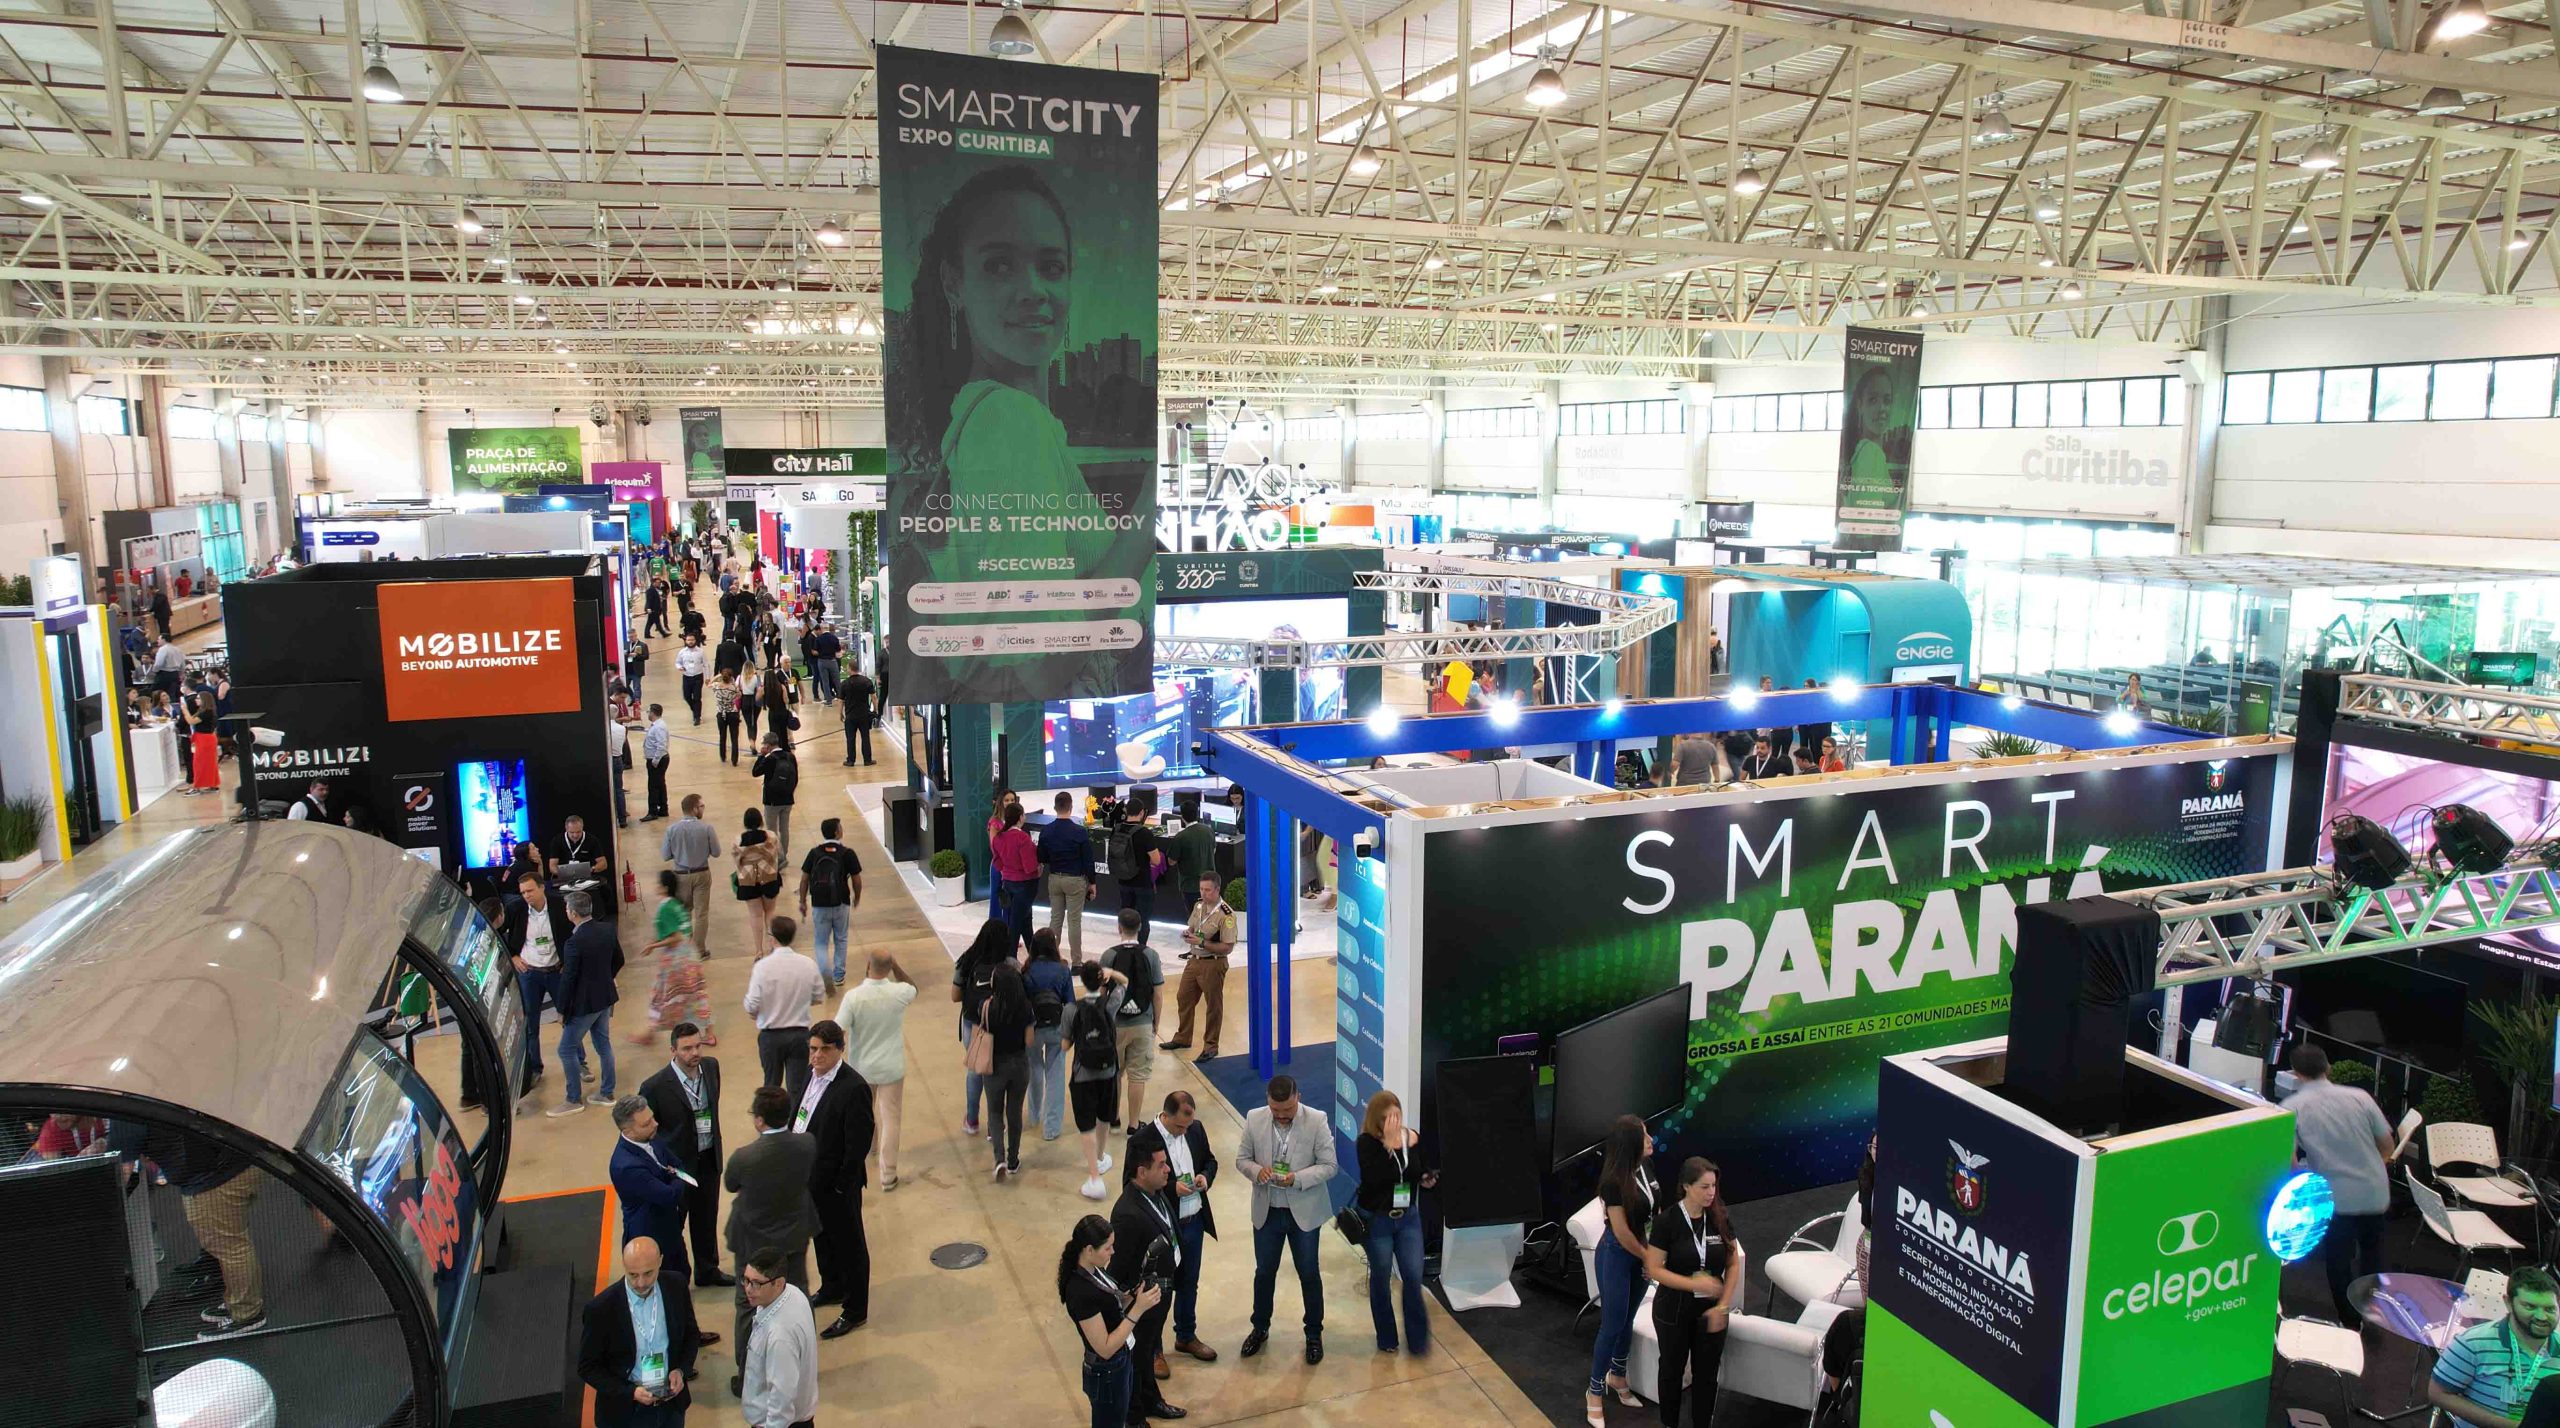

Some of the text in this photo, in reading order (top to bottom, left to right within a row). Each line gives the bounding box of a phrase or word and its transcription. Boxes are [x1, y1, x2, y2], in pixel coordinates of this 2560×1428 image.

[898, 83, 1142, 138] SMARTCITY
[898, 126, 1052, 155] EXPO CURITIBA
[1850, 338, 1918, 358] SMARTCITY
[682, 410, 719, 418] SMARTCITY
[1167, 402, 1204, 410] SMARTCITY
[2045, 435, 2083, 452] Sala
[466, 447, 537, 461] PRAÇA DE
[773, 454, 853, 473] City Hall
[467, 461, 568, 478] ALIMENTAÇÃO
[2021, 449, 2169, 487] Curitiba
[925, 493, 1123, 511] CONNECTING CITIES
[899, 514, 1147, 533] PEOPLE & TECHNOLOGY
[977, 557, 1076, 572] #SCECWB23
[1007, 636, 1035, 645] iCities
[1044, 635, 1092, 644] SMARTCITY
[401, 655, 539, 671] BEYOND AUTOMOTIVE
[290, 768, 350, 779] AUTOMOTIVE
[2181, 790, 2244, 814] PARANÁ
[1622, 790, 2076, 915] SMART
[2479, 942, 2515, 958] Imagine
[2516, 954, 2532, 963] um
[1688, 1040, 1747, 1060] GROSSA
[1751, 1038, 1760, 1050] E
[1763, 1027, 1806, 1047] ASSAÍ
[1810, 1022, 1854, 1040] ENTRE
[1857, 1019, 1875, 1033] AS
[1878, 1017, 1891, 1030] 21
[1894, 1002, 1988, 1028] COMUNIDADES
[1896, 1185, 2035, 1297] PARANÁ
[1895, 1223, 2034, 1315] GOVERNO DO ESTADO
[1901, 1243, 2024, 1329] SECRETARIA DA INOVAÇÃO,
[1922, 1269, 1995, 1322] MODERNIZAÇÃO
[2102, 1253, 2258, 1320] celepar
[1898, 1266, 2024, 1356] E TRANSFORMAÇÃO DIGITAL
[2184, 1296, 2247, 1322] +gov+tech
